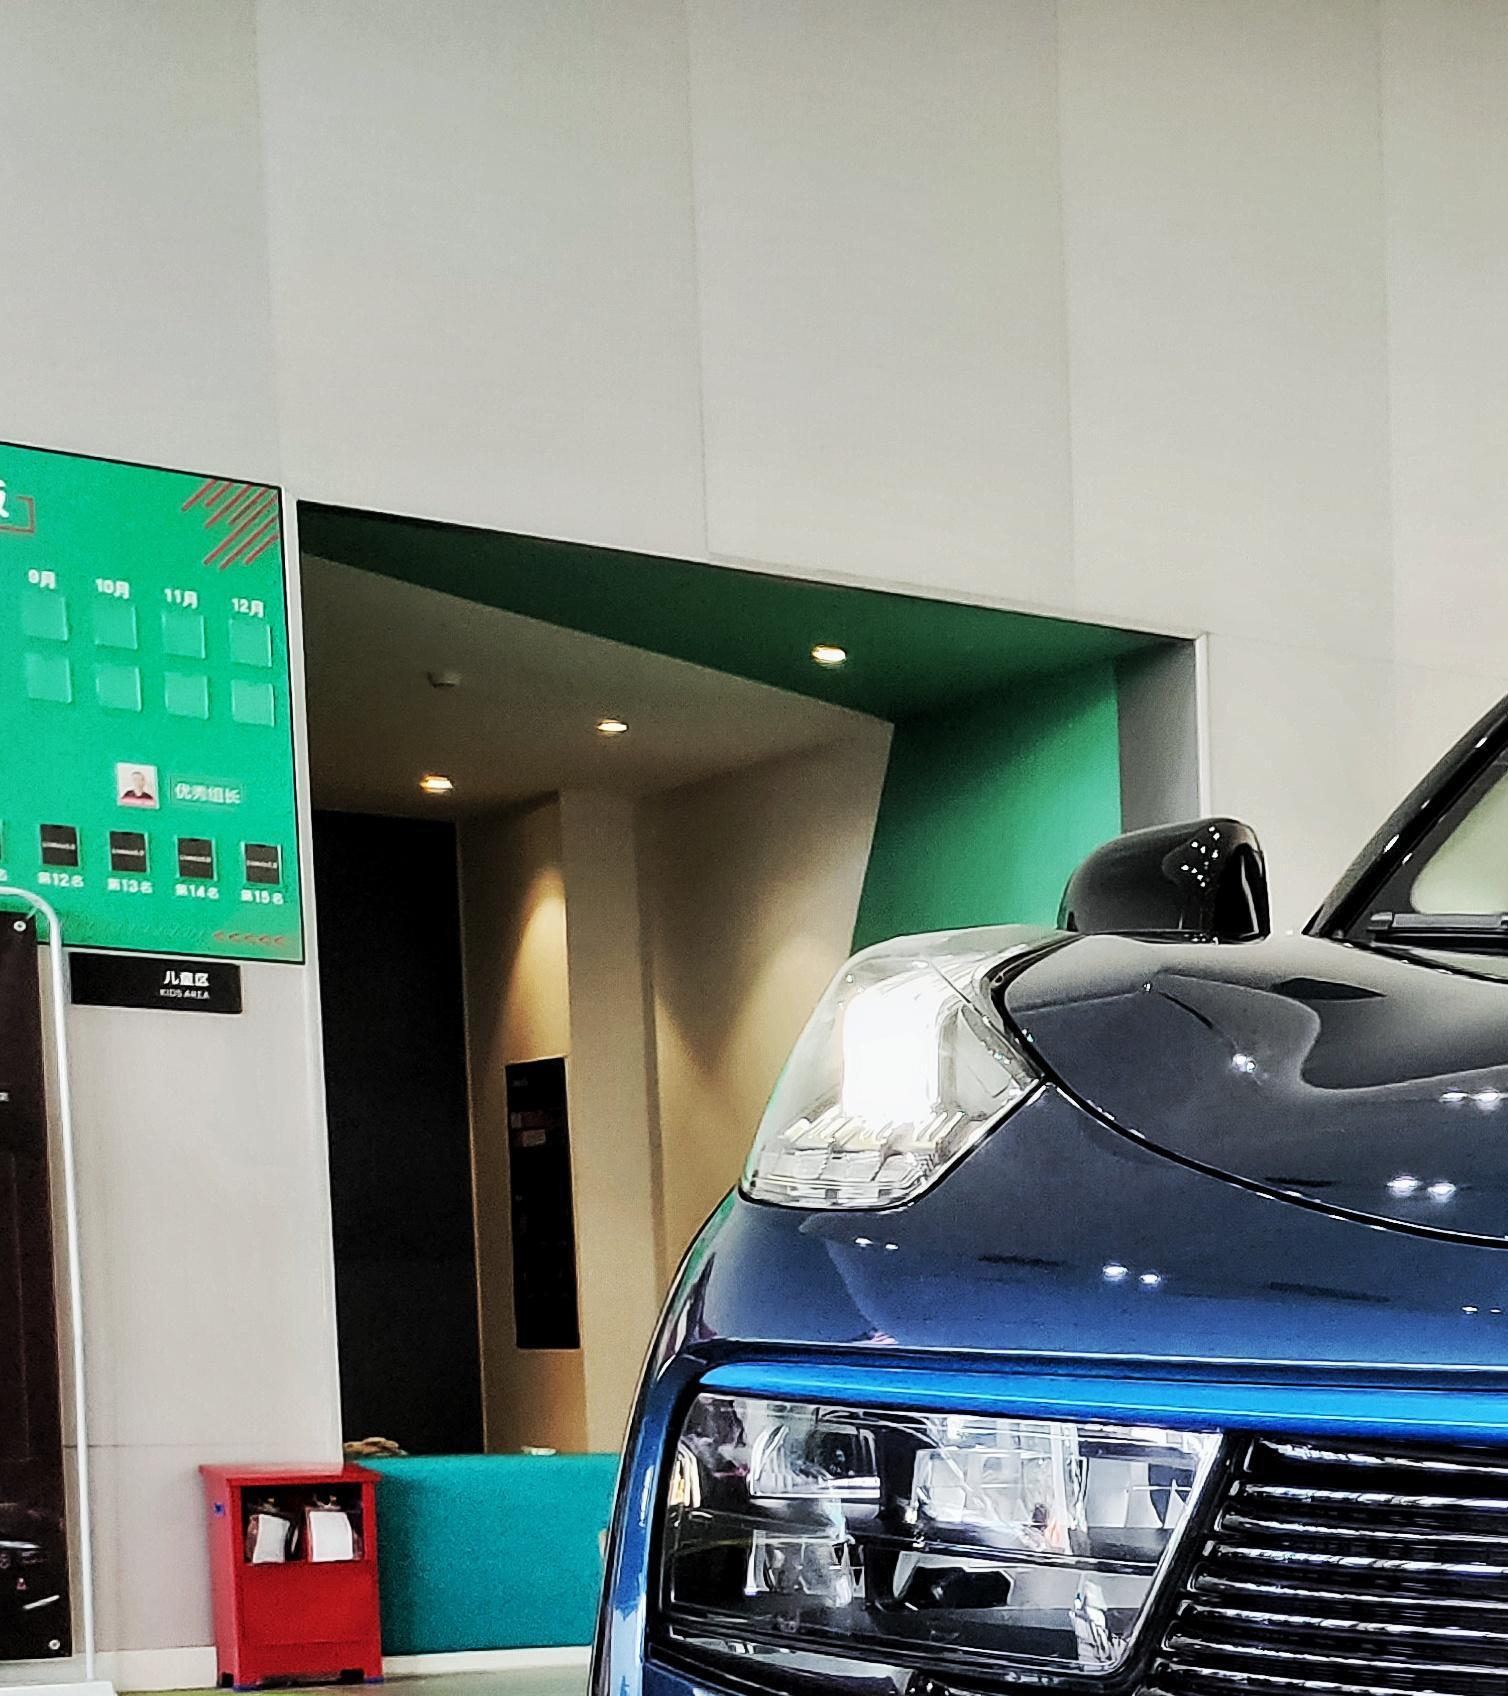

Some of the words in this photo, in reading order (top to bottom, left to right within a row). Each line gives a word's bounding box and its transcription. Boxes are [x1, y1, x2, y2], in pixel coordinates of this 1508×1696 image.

[27, 569, 56, 589] 9月
[95, 578, 130, 600] 10月
[164, 588, 198, 609] 11月
[231, 597, 265, 618] 12月
[163, 970, 210, 987] 儿童区
